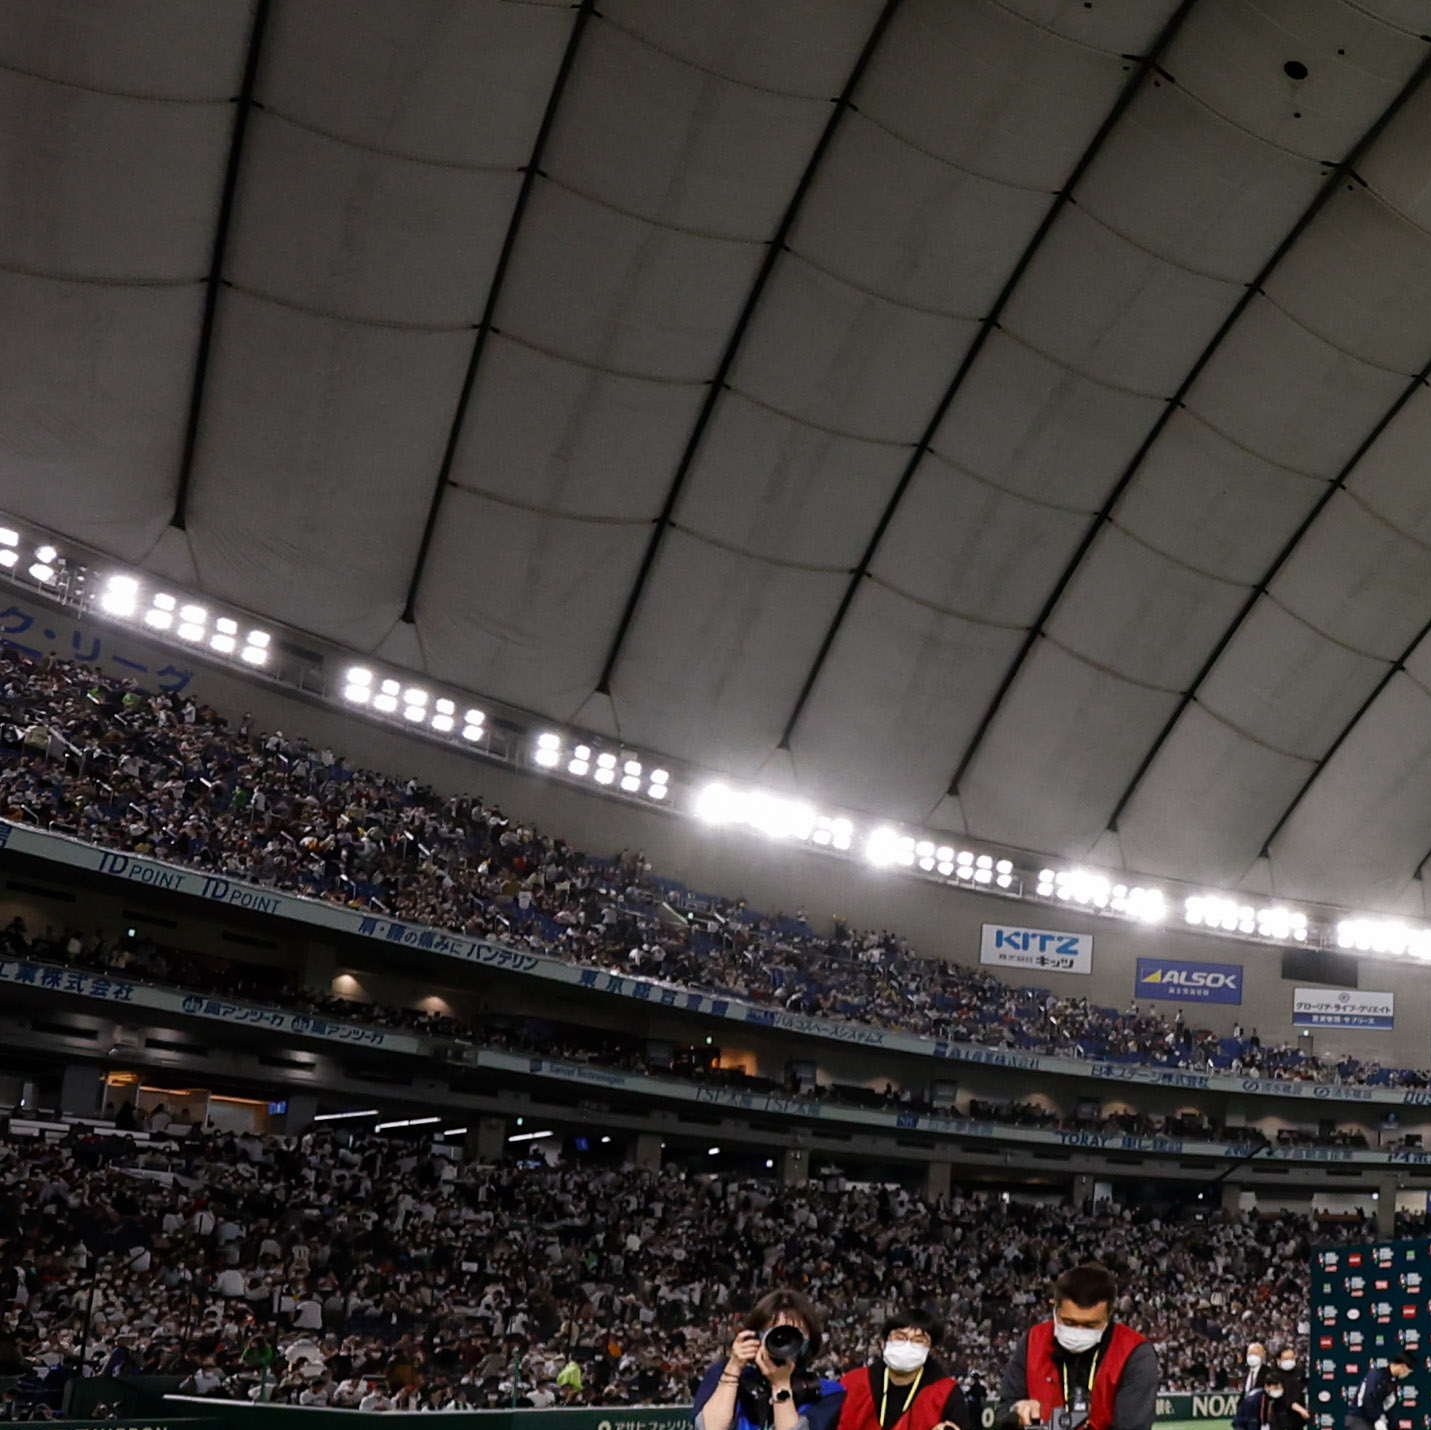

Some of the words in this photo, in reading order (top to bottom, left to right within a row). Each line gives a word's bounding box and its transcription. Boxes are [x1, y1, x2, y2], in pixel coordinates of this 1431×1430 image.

[128, 864, 186, 891] POINT
[229, 889, 282, 915] POINT
[995, 929, 1080, 955] KITZ
[1162, 970, 1238, 990] ALSOK
